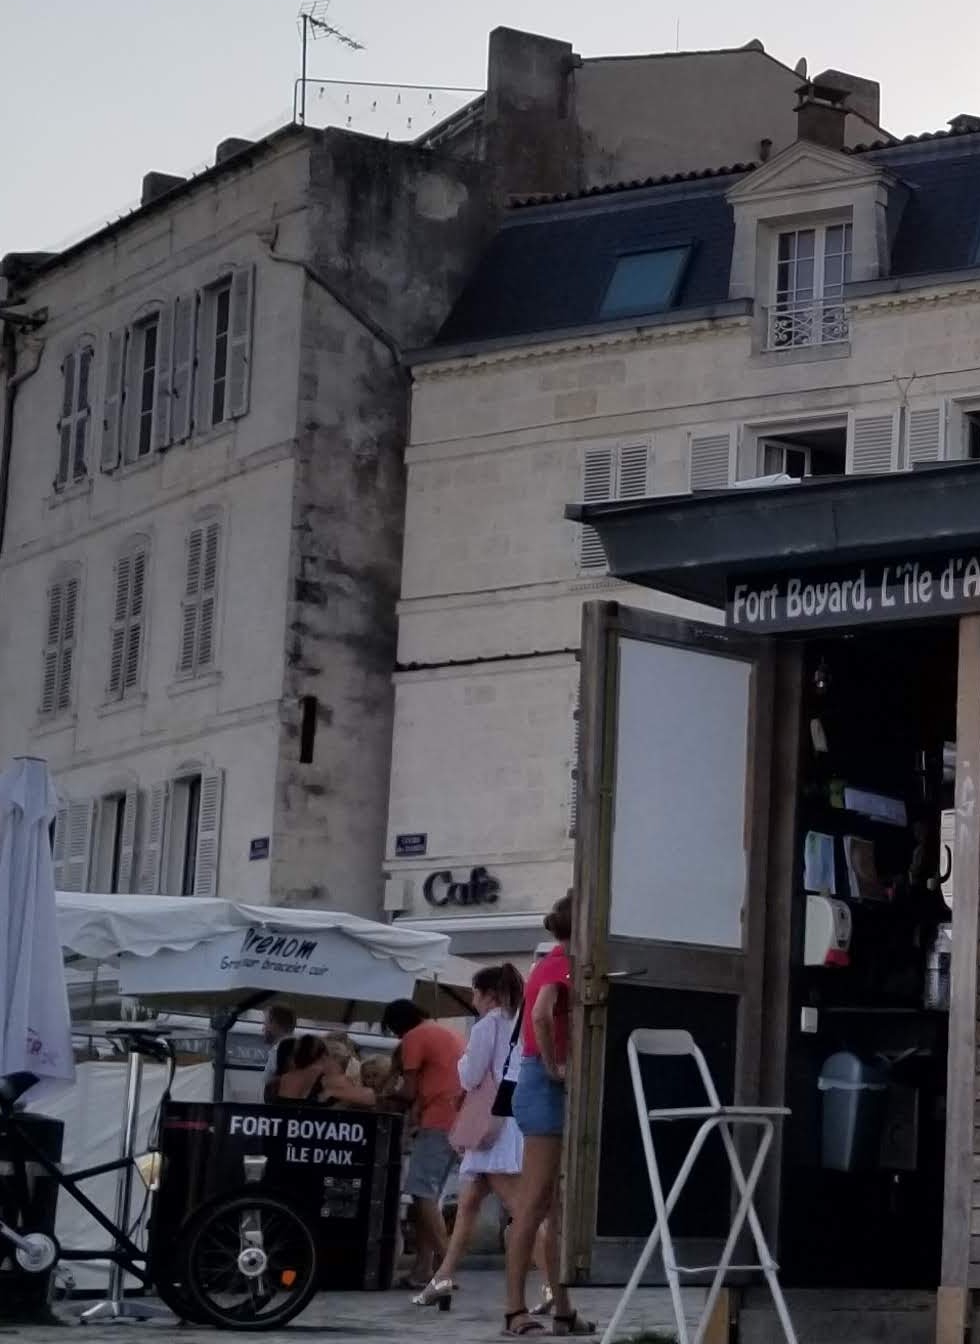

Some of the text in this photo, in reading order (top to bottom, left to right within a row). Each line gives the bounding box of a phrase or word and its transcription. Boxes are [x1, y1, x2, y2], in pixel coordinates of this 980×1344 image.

[733, 583, 779, 624] Fort
[786, 569, 872, 619] Boyard,
[230, 1116, 368, 1146] FORT BOYARD,
